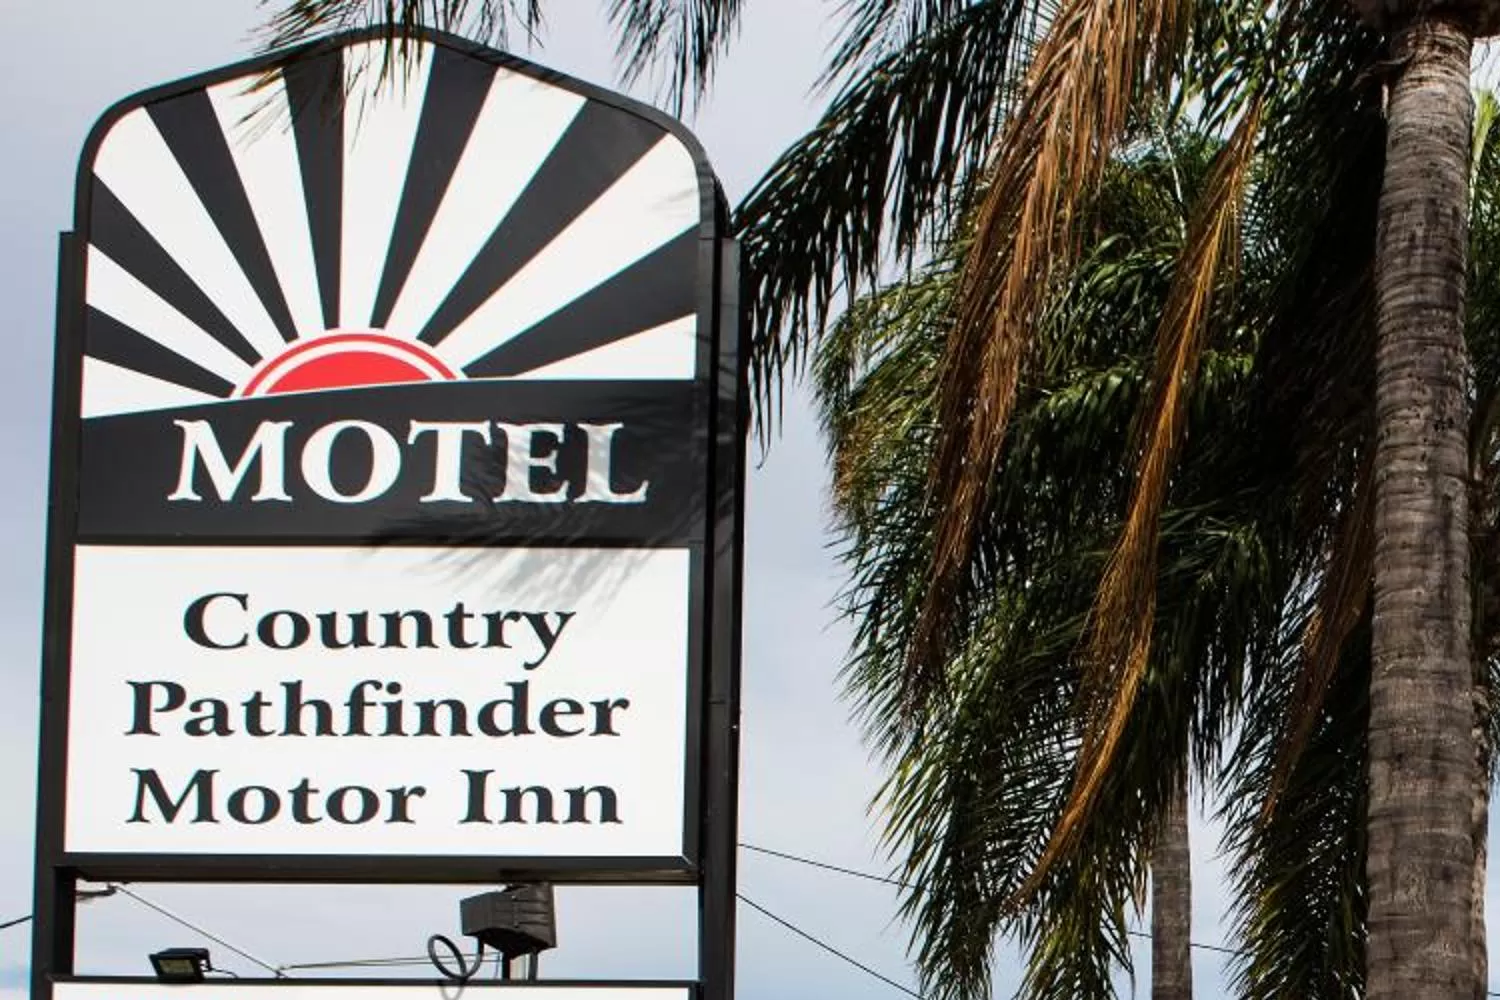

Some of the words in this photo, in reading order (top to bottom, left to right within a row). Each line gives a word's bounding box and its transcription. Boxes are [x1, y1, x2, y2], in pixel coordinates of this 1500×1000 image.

[167, 418, 650, 504] MOTEL
[183, 591, 577, 671] Country
[123, 678, 631, 739] Pathfinder
[125, 767, 427, 826] Motor
[457, 768, 625, 826] Inn
